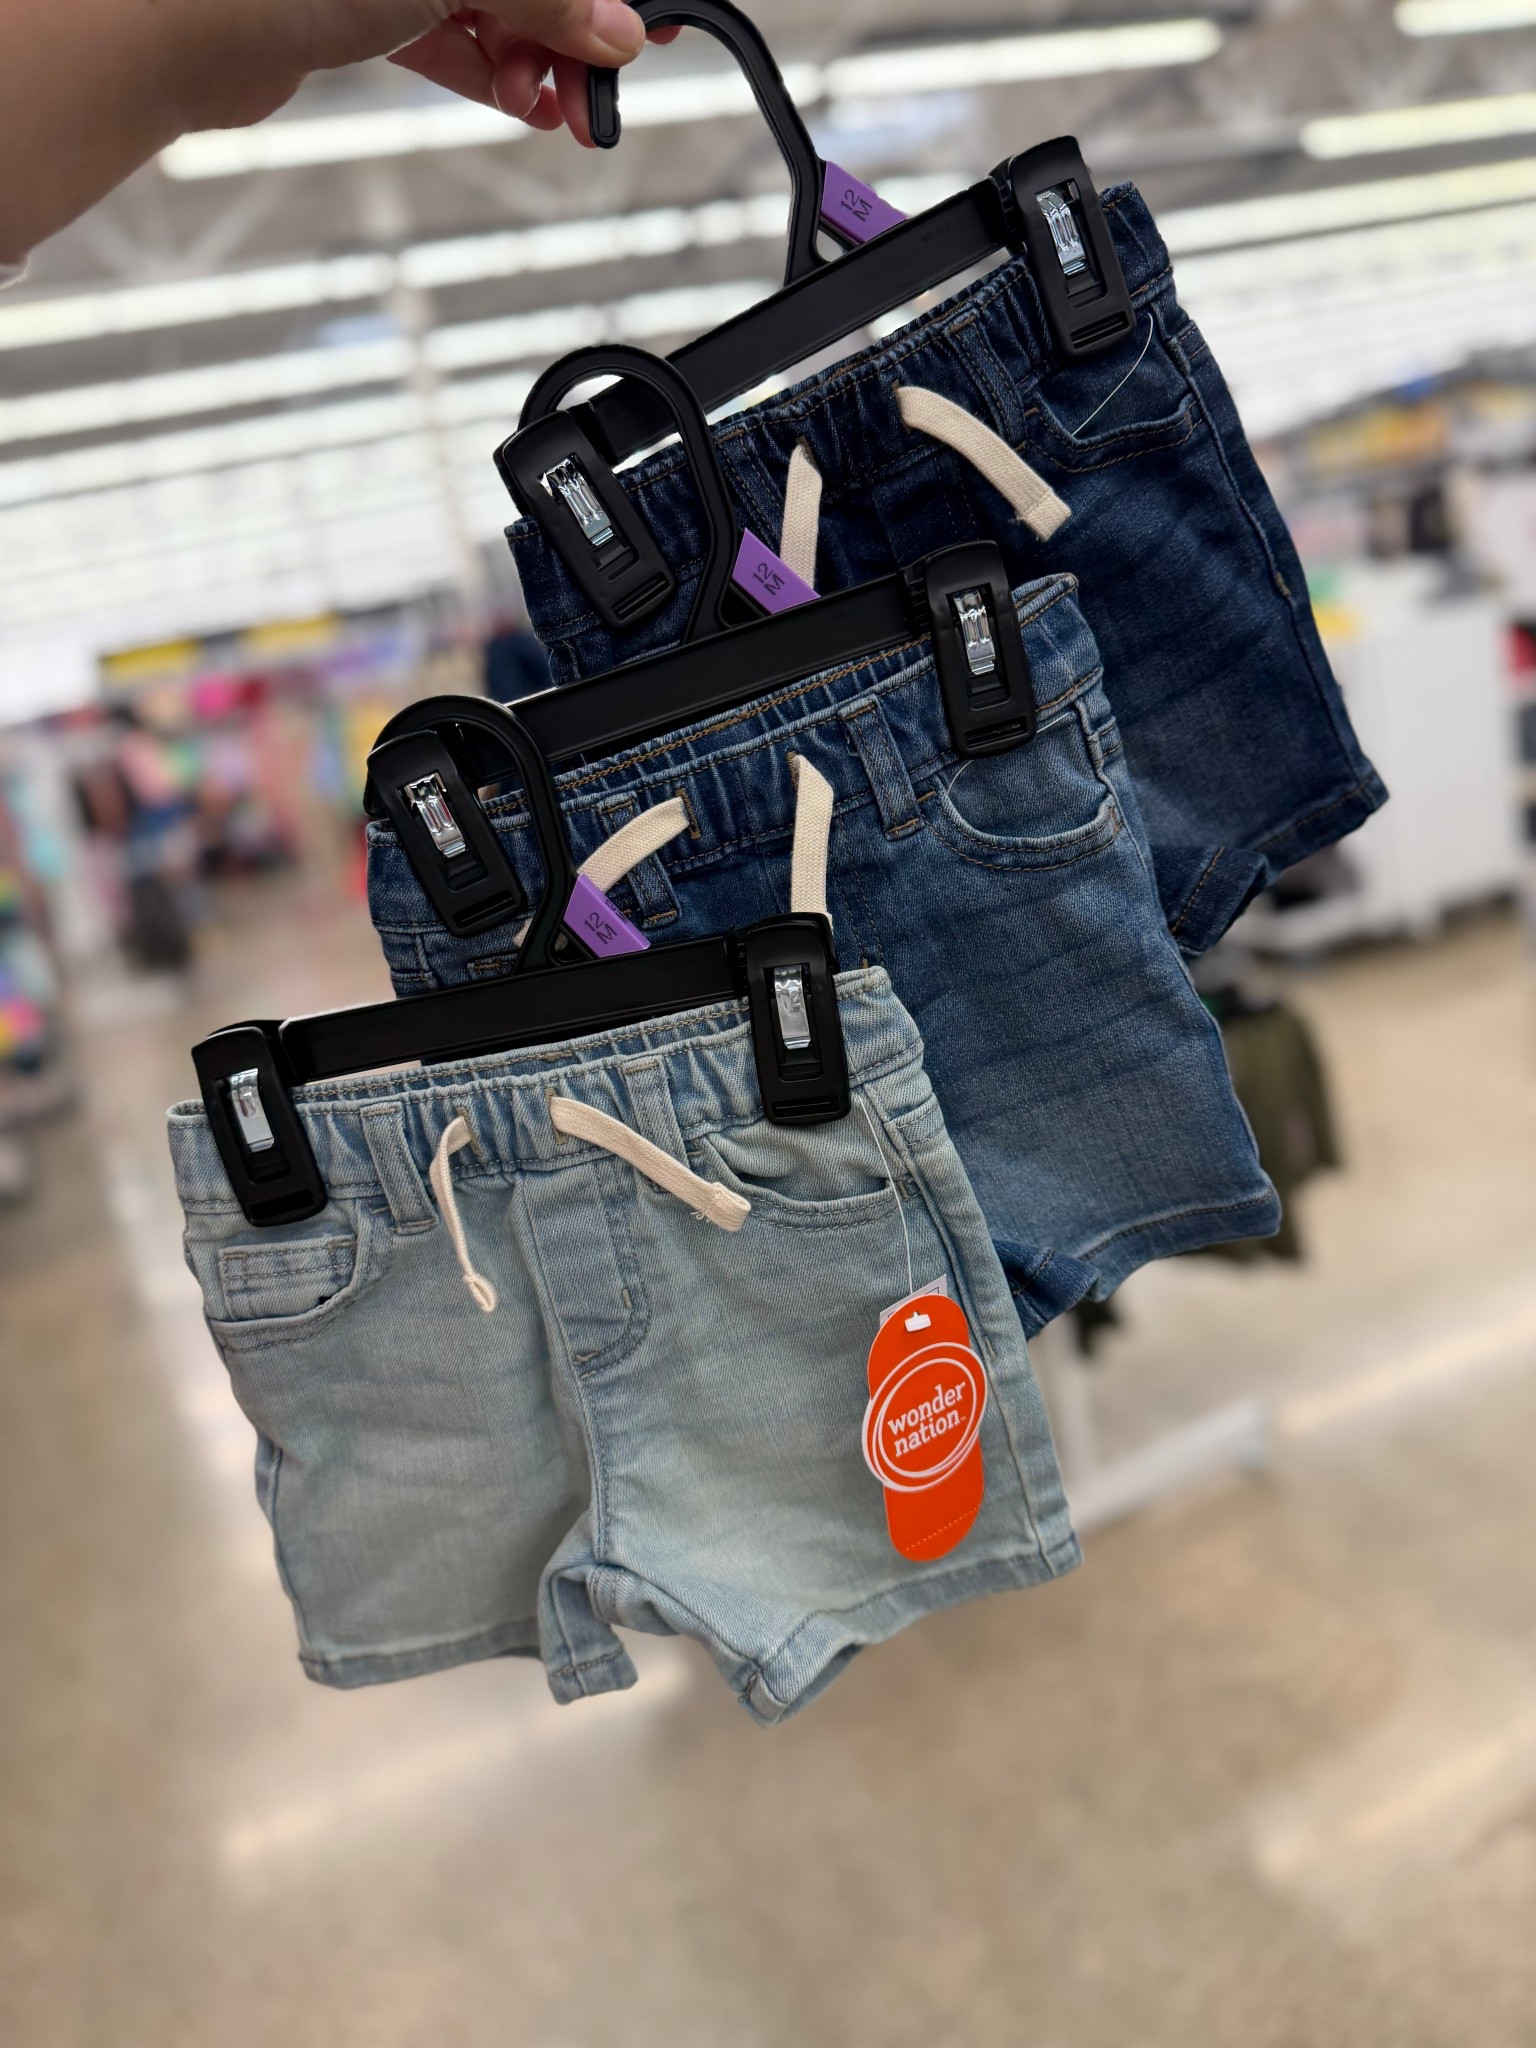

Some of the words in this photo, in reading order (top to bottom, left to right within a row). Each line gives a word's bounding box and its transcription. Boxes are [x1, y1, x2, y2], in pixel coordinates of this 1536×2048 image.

[840, 189, 860, 211] 12
[853, 198, 873, 222] M
[752, 562, 774, 584] 12
[763, 572, 786, 596] M
[583, 912, 605, 932] 12
[596, 923, 618, 945] M
[887, 1381, 966, 1436] wonder
[894, 1409, 960, 1458] nation
